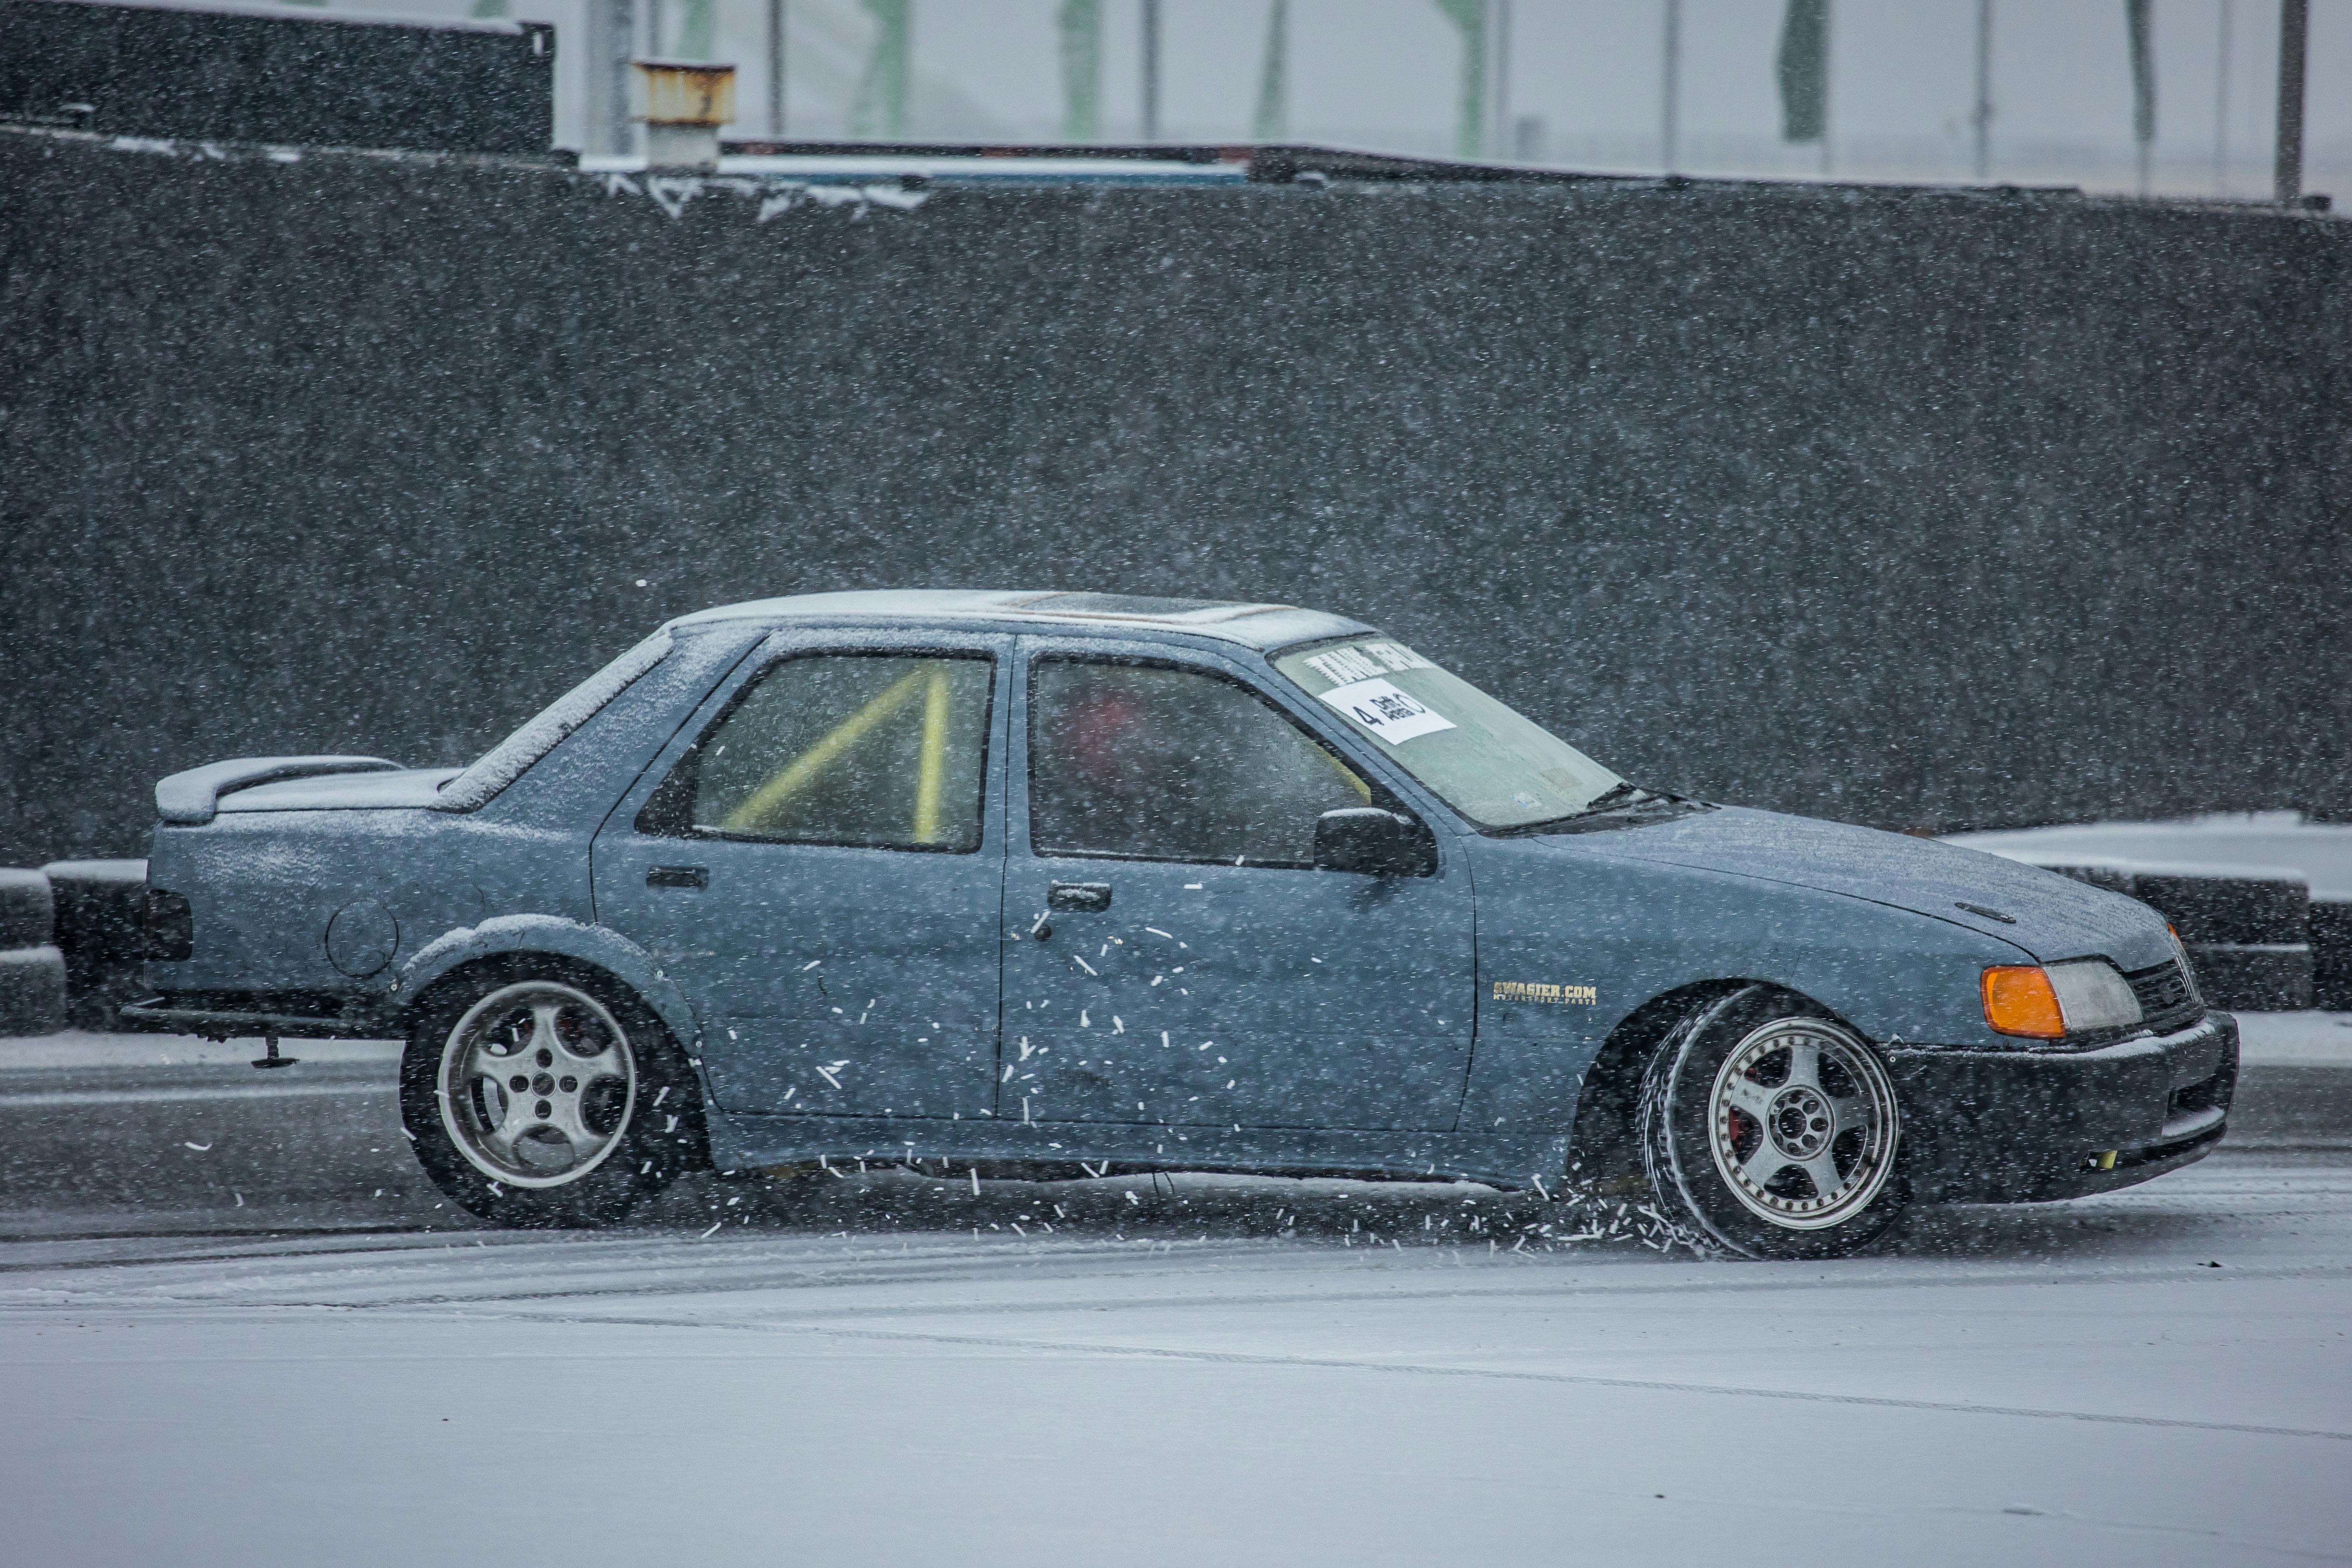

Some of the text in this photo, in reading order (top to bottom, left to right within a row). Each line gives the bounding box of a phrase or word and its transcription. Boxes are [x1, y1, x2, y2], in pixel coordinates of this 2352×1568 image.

[1369, 696, 1401, 710] Drift
[1352, 706, 1384, 726] 4
[1380, 708, 1416, 721] Arena
[1493, 982, 1596, 998] SWAGIER.COM
[1493, 993, 1559, 1003] MOTORSPORT
